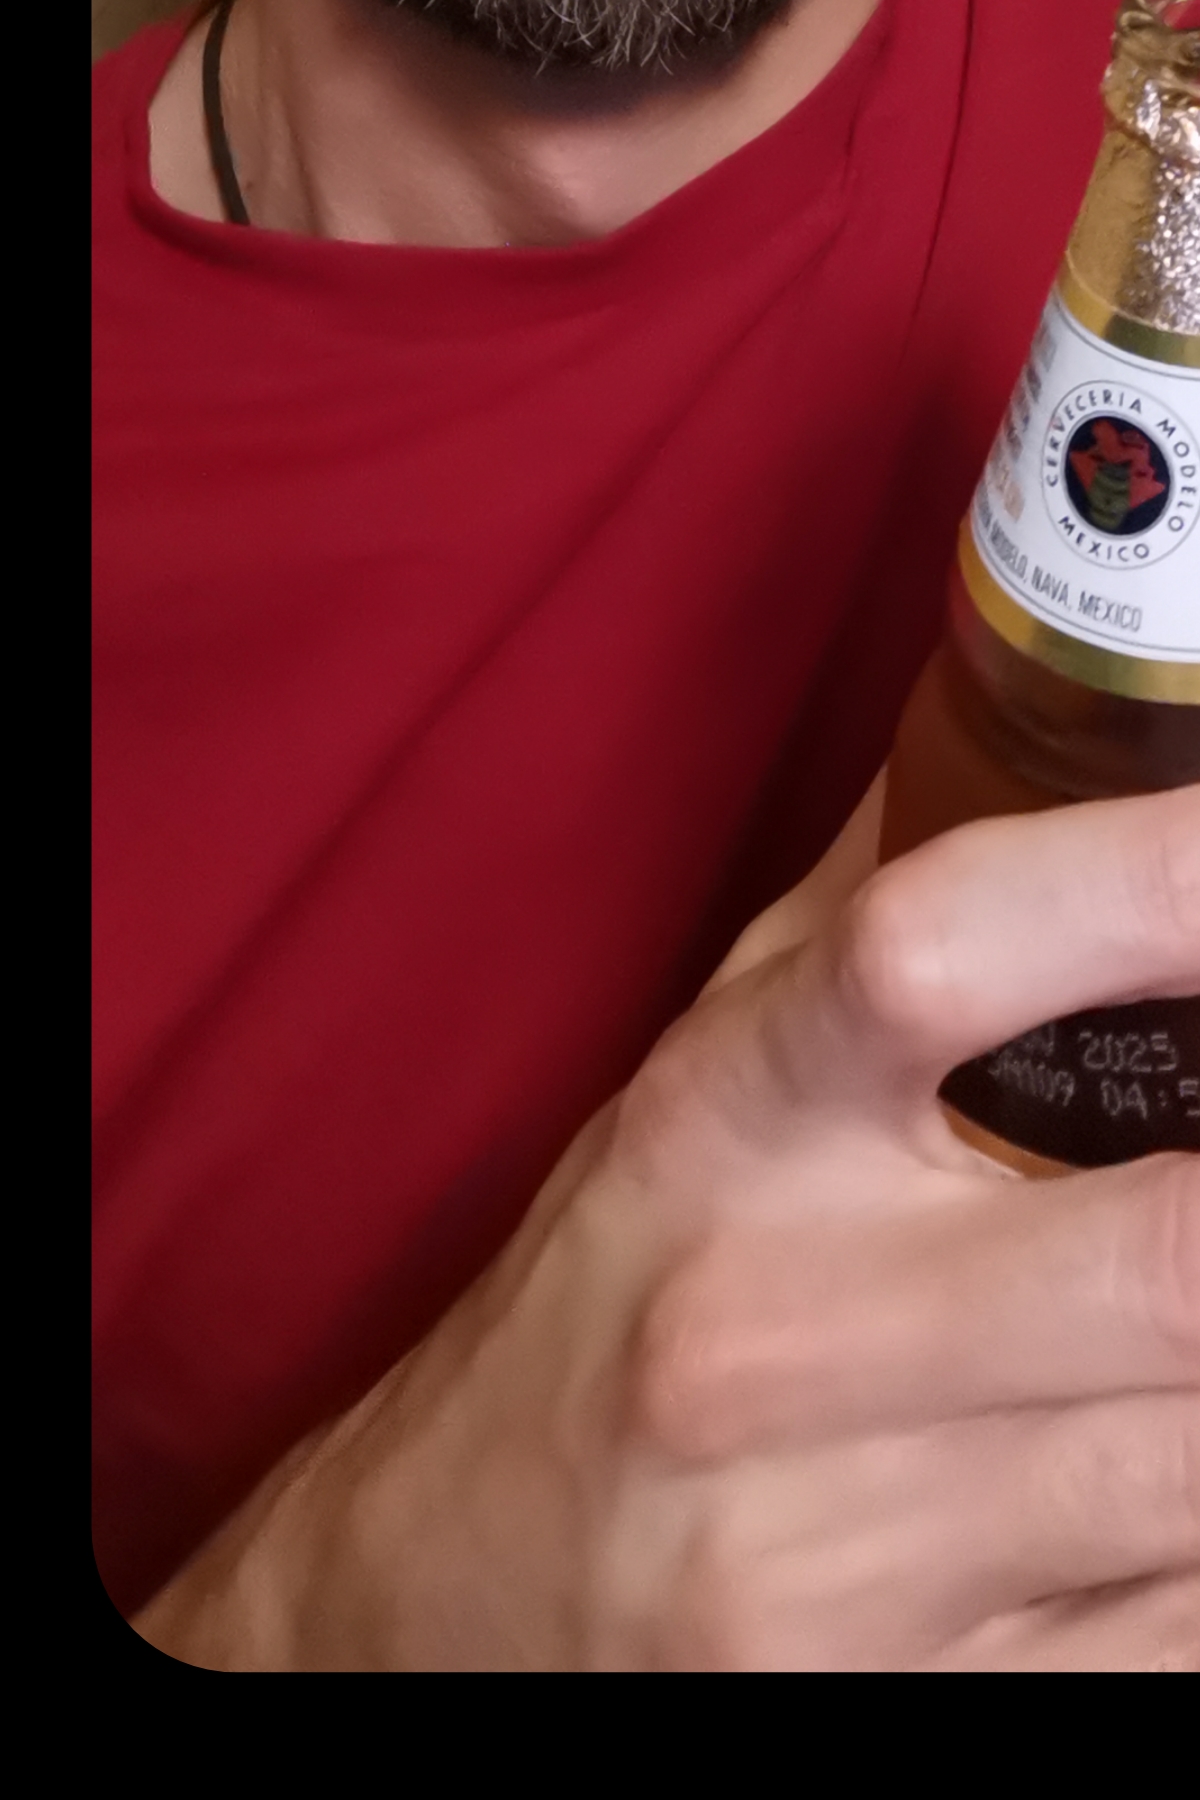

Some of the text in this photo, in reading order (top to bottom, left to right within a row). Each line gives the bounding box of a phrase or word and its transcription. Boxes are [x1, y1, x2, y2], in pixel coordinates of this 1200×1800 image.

[1046, 388, 1143, 488] CERVECERIA
[1155, 418, 1197, 533] MODELO
[1057, 514, 1151, 562] MEXICO
[1079, 589, 1144, 634] MEXICO
[1078, 1029, 1180, 1074] 2025
